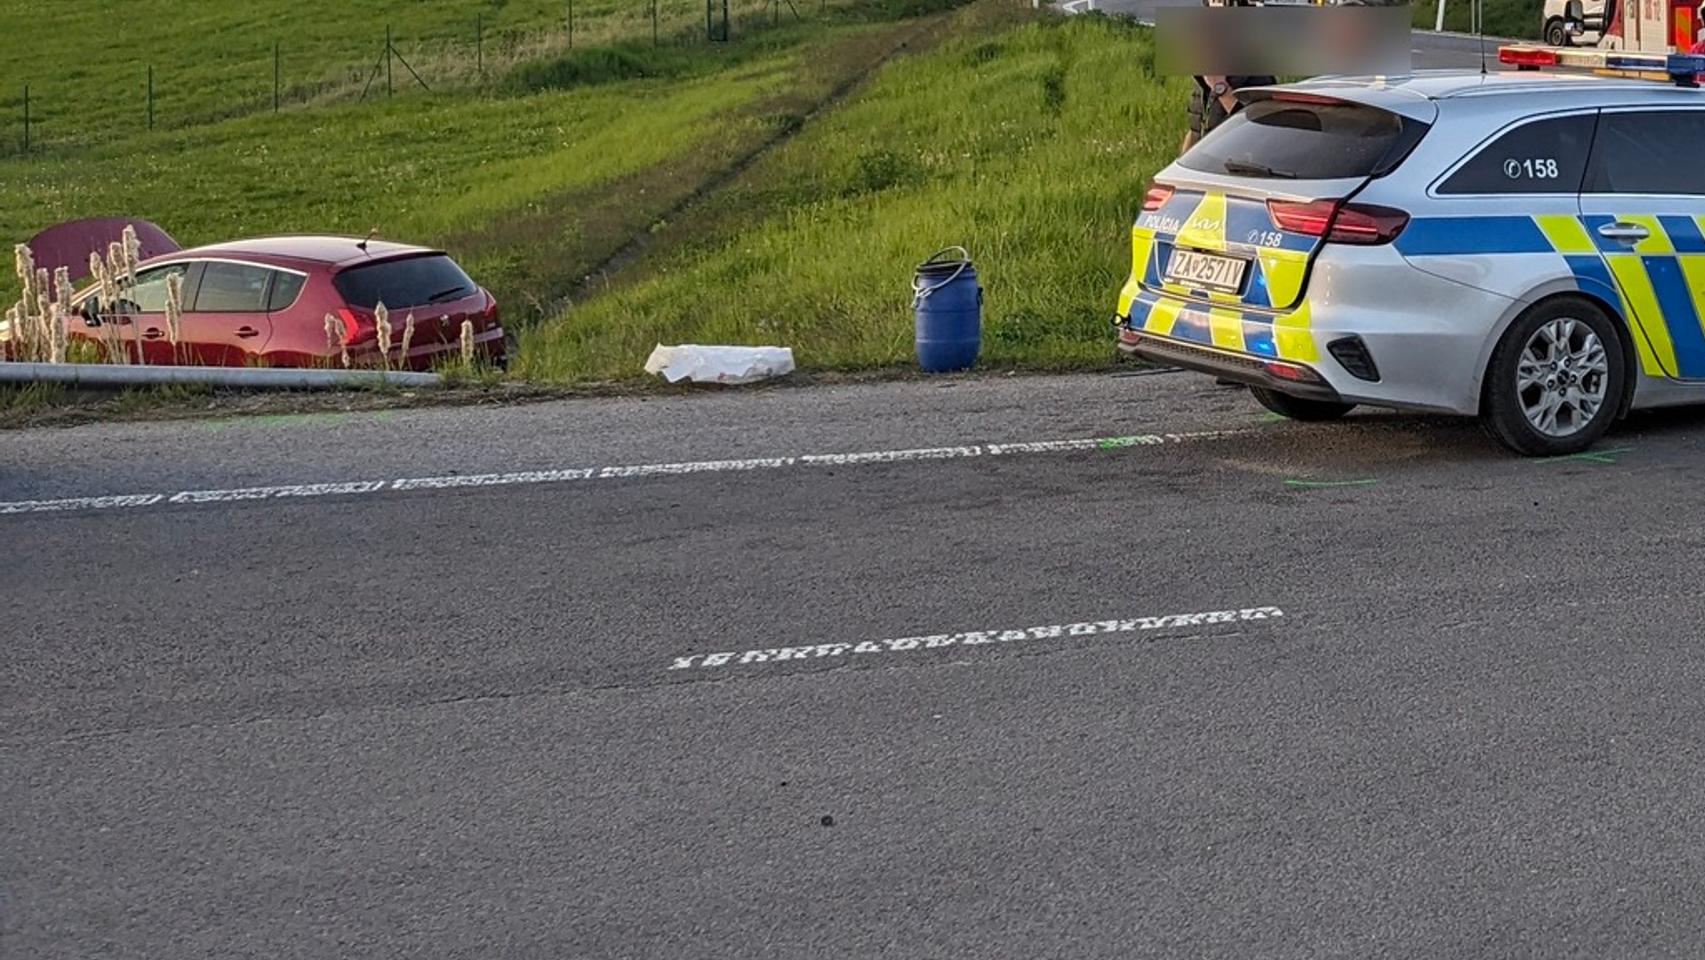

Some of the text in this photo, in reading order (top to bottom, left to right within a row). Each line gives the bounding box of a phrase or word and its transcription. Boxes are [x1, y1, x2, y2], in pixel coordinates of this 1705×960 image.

[1523, 158, 1559, 179] 158
[1144, 214, 1180, 231] POLÍCIA
[1259, 231, 1283, 248] 158
[1173, 252, 1193, 277] ZA
